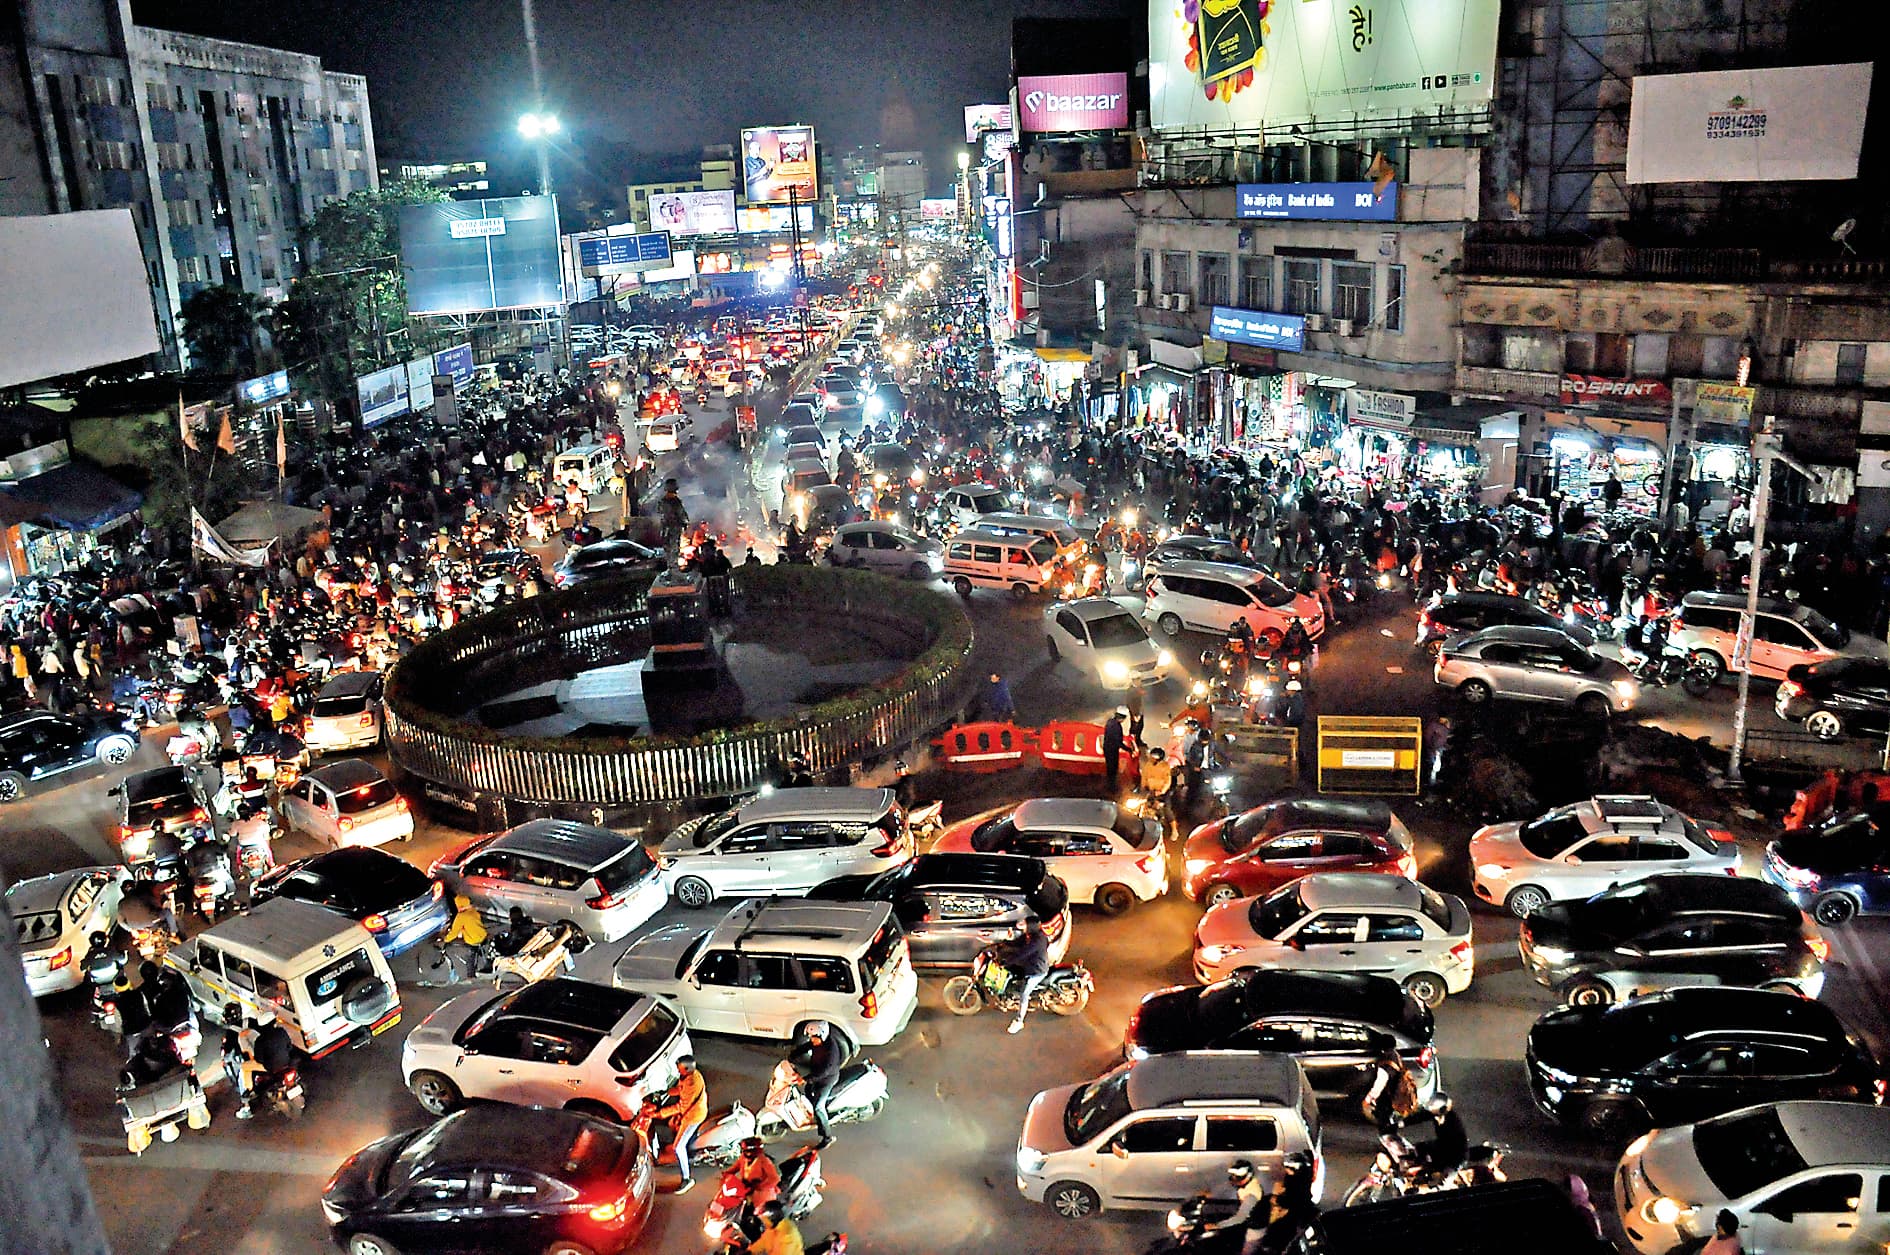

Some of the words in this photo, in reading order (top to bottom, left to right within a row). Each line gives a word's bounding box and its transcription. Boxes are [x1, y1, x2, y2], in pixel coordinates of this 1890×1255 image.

[1046, 92, 1120, 112] baazar
[1707, 114, 1767, 130] 9709142299
[1288, 193, 1306, 206] Bank
[1307, 193, 1315, 206] of
[1315, 193, 1335, 207] India
[1355, 193, 1373, 208] BOI
[319, 960, 355, 983] AMBULANCE
